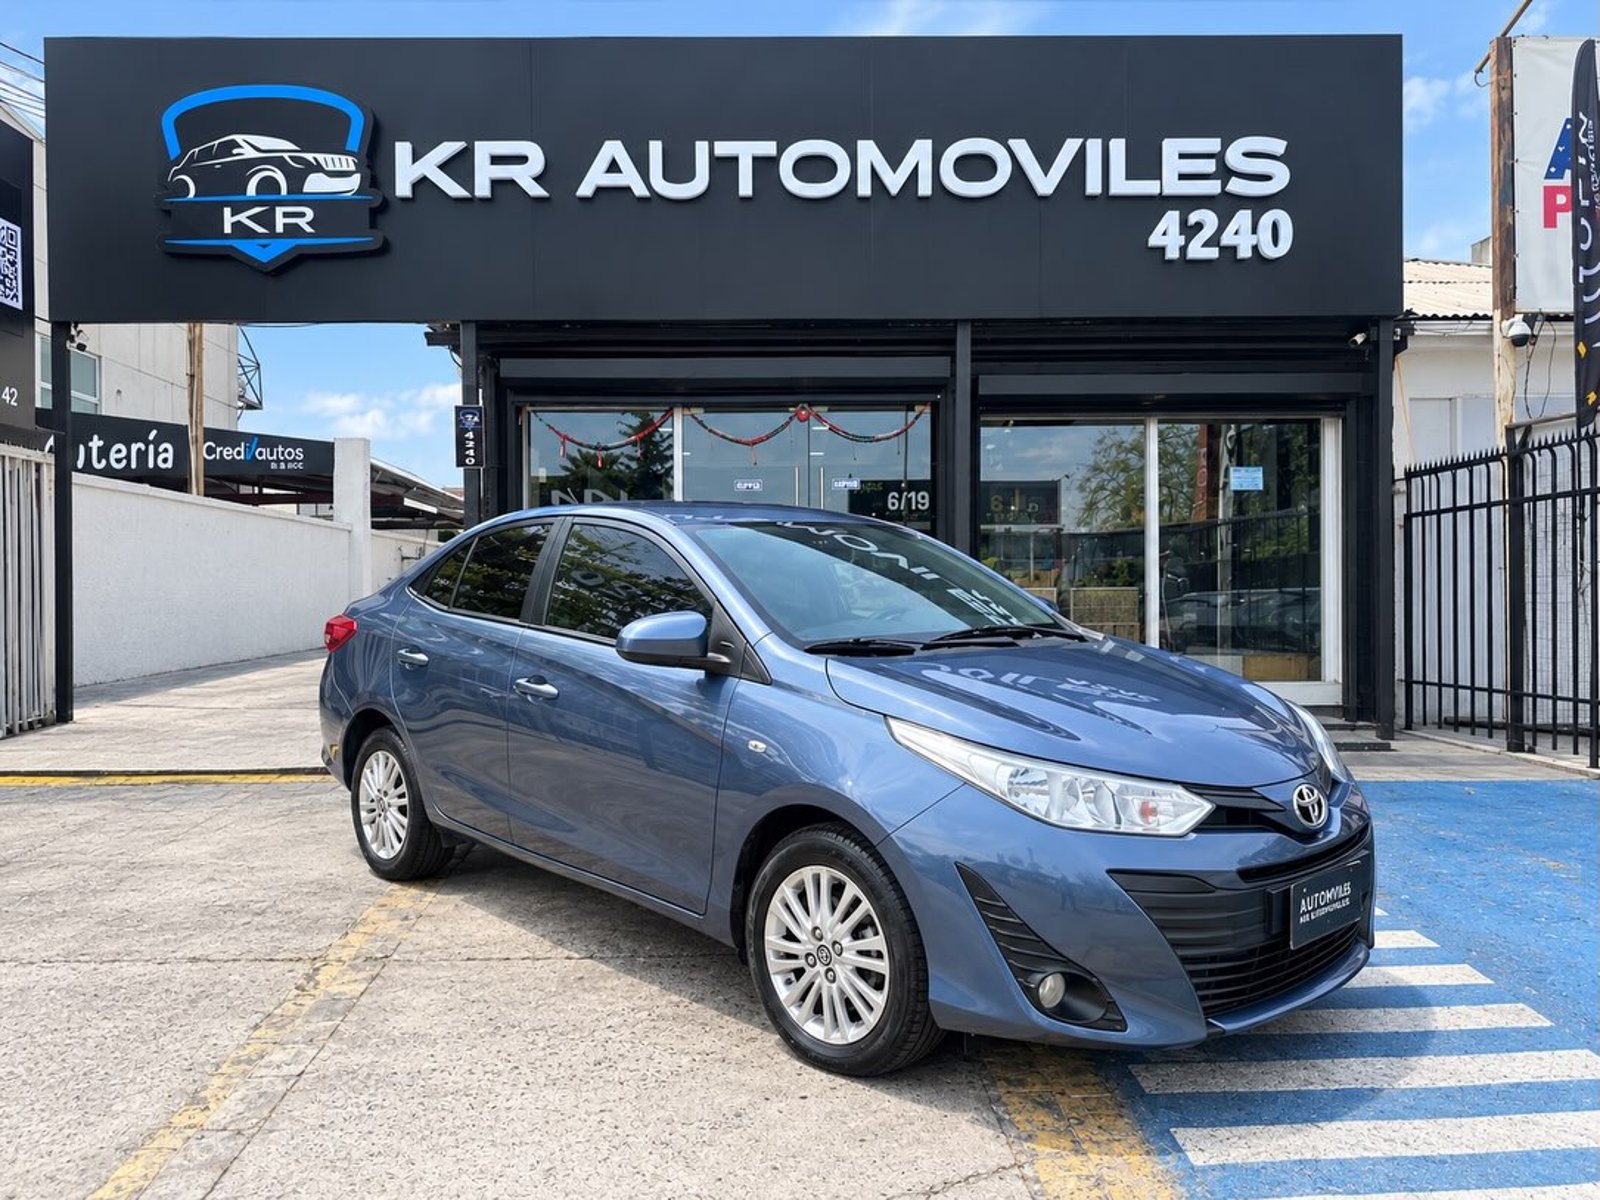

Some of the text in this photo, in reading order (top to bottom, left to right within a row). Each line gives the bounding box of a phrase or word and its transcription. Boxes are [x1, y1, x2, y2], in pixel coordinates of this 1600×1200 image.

[394, 135, 1292, 201] KR AUTOMOVILES
[223, 205, 316, 234] KR
[1147, 208, 1294, 261] 4240
